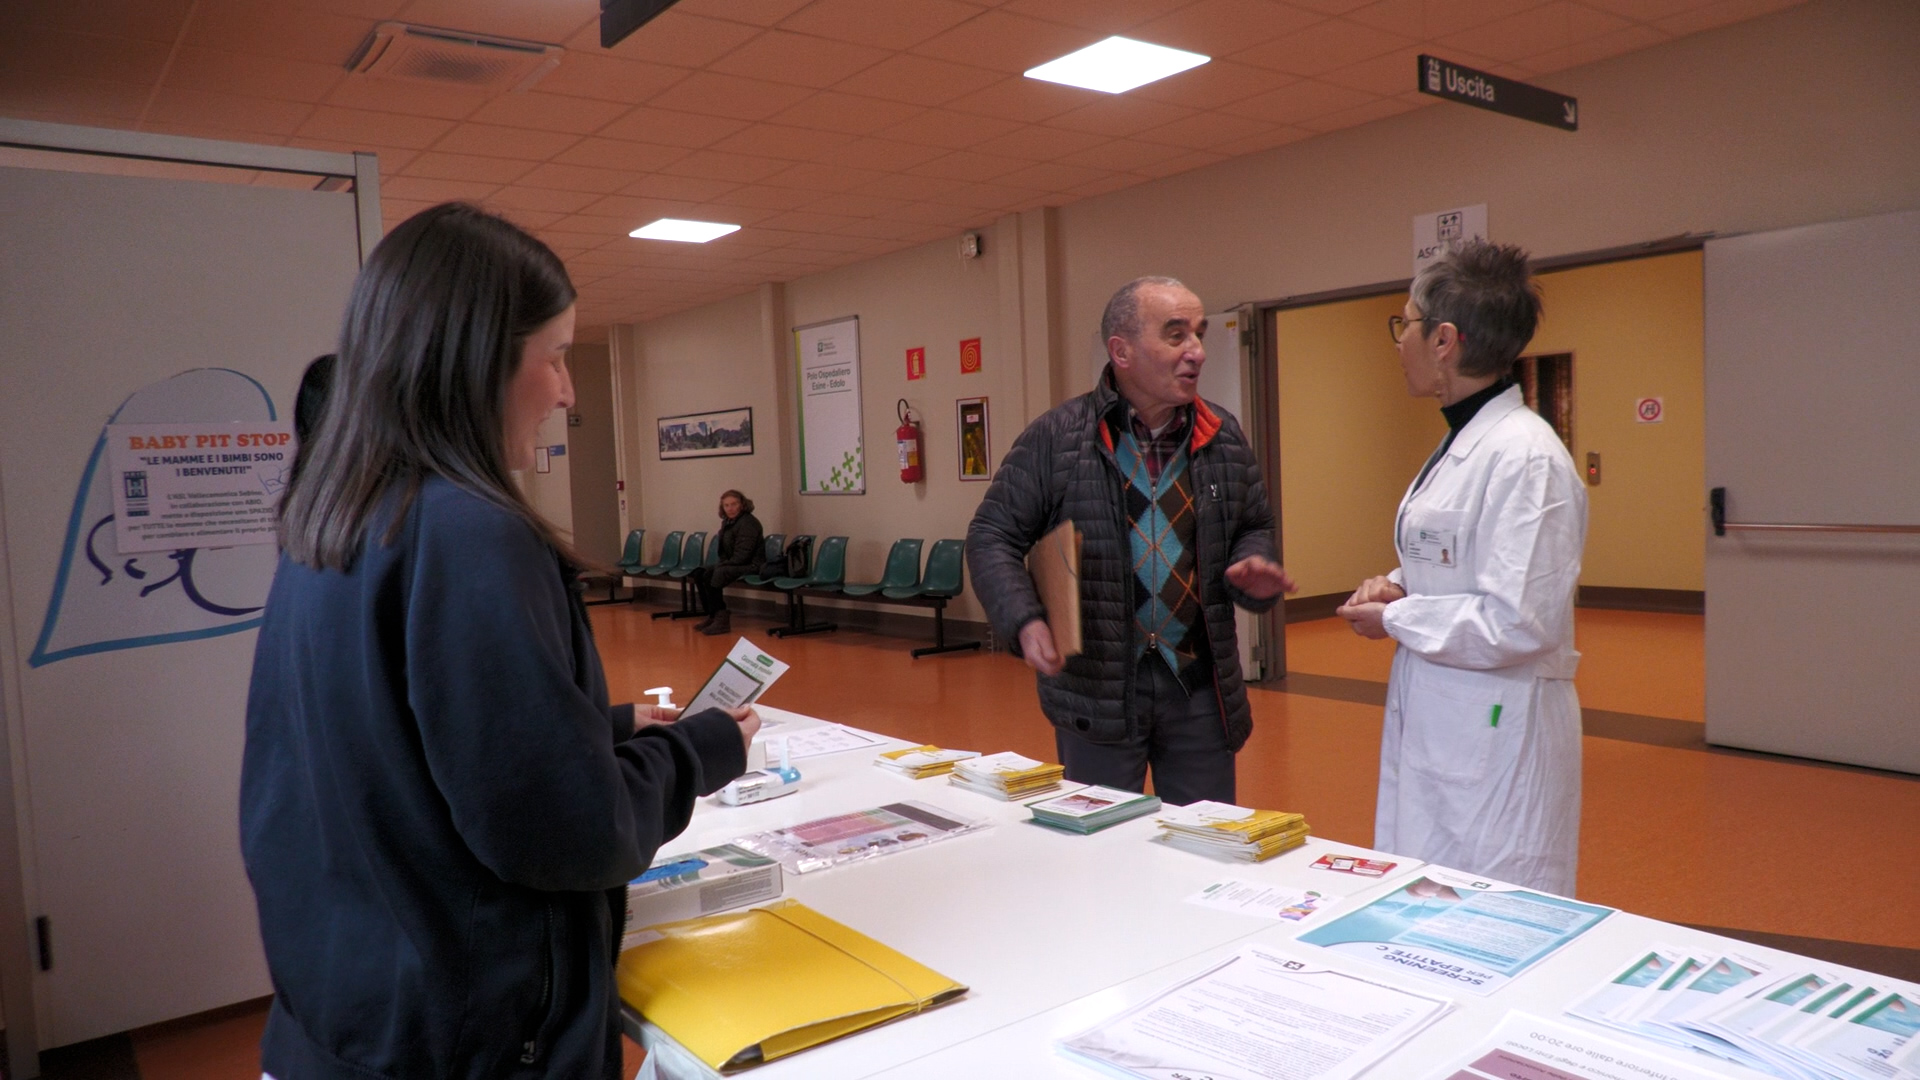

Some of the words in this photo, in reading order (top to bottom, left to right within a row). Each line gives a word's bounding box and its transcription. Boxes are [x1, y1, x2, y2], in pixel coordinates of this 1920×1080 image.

[1445, 67, 1496, 102] Uscita
[807, 372, 818, 381] Polo
[818, 368, 851, 379] Ospedaliero
[812, 382, 826, 391] Esine
[829, 380, 845, 389] Edolo
[129, 435, 189, 450] BABY
[195, 434, 231, 449] PIT
[236, 433, 291, 447] STOP
[162, 455, 205, 465] MAMME
[207, 455, 214, 463] E
[216, 454, 220, 463] I
[222, 453, 252, 463] BIMBI
[254, 452, 284, 462] SONO
[176, 469, 181, 477] I
[182, 466, 253, 477] BENVENUTI!"
[1390, 949, 1465, 973] EPATITE
[1383, 954, 1485, 986] SCREENING
[1466, 970, 1494, 980] PER
[1529, 1031, 1564, 1048] 20:00
[1565, 1043, 1584, 1053] ore
[1585, 1048, 1614, 1063] dalle
